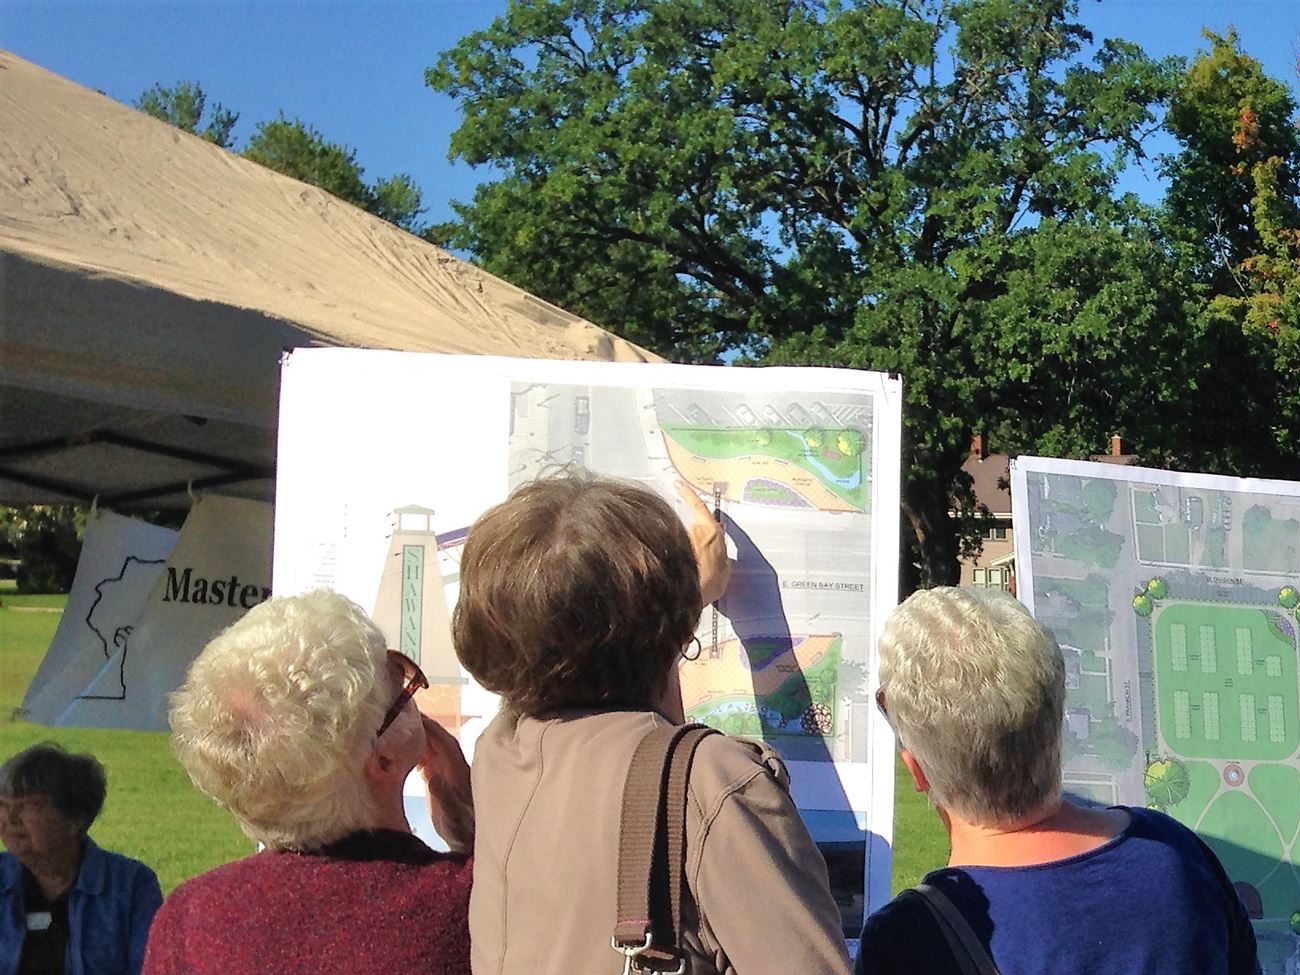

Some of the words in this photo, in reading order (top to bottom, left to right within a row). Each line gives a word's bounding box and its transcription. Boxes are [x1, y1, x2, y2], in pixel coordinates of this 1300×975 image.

[791, 581, 817, 590] GREEN
[818, 582, 834, 590] BAY
[836, 583, 864, 591] STREET
